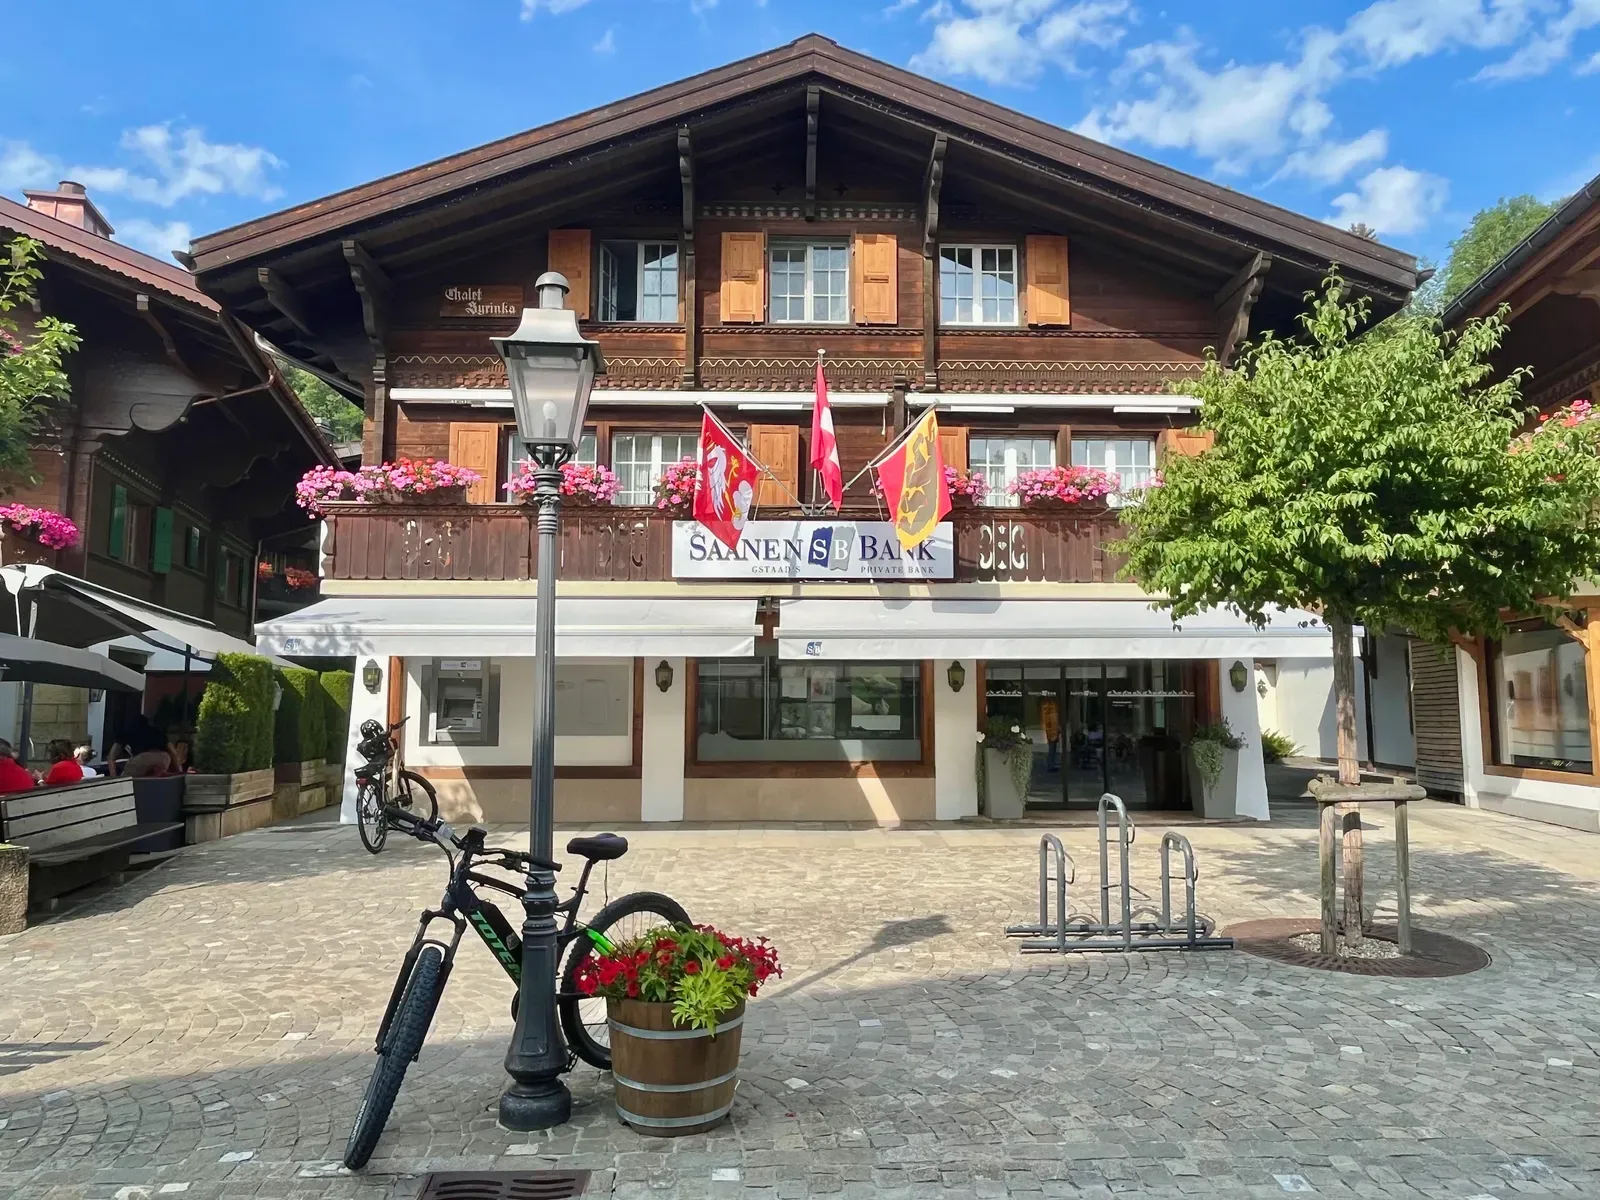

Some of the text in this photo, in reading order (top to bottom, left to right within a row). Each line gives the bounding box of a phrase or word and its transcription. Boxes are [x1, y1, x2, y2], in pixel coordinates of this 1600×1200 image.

[444, 287, 483, 302] Chalet
[812, 538, 849, 560] SB
[751, 565, 935, 574] GSTAAD'S PRIVATE BANK
[807, 645, 821, 654] SB
